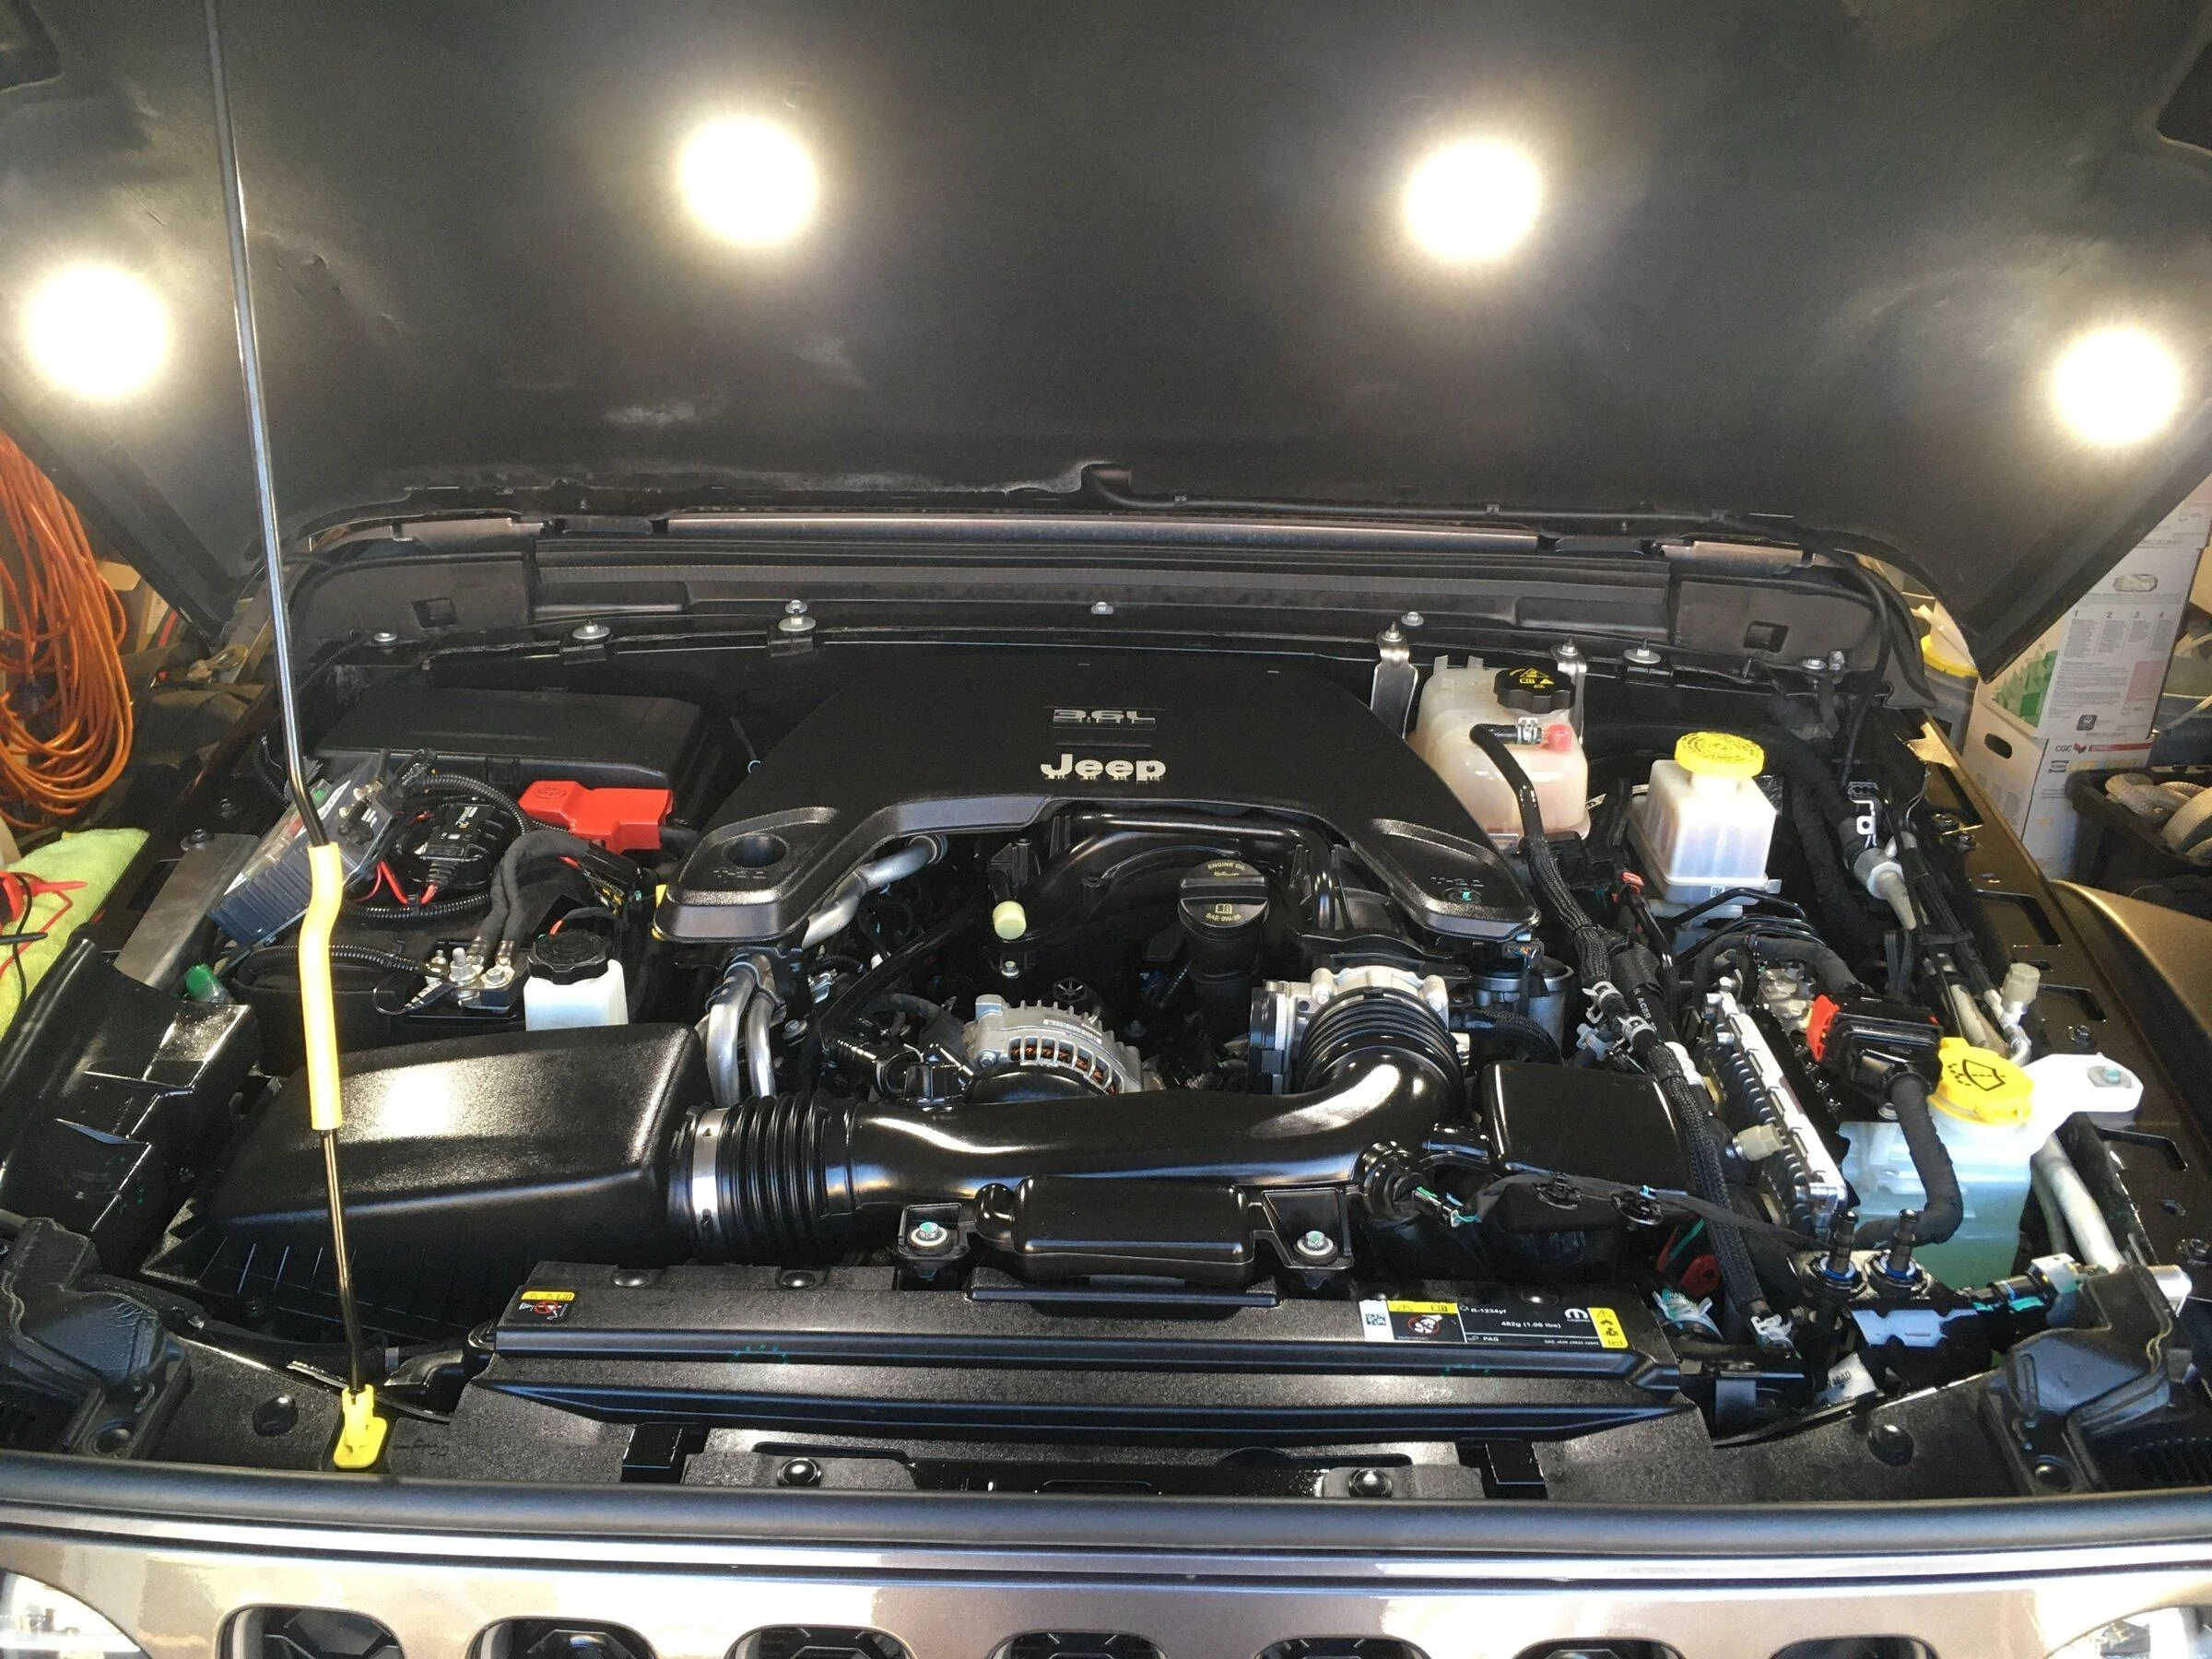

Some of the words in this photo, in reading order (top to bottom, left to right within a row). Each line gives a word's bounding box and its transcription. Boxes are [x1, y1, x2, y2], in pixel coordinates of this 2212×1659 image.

[1053, 709, 1156, 724] 3.6L
[1040, 753, 1166, 783] Jeep
[1235, 863, 1246, 871] OIL
[1206, 912, 1219, 922] SAE
[1220, 913, 1241, 922] 0W-20
